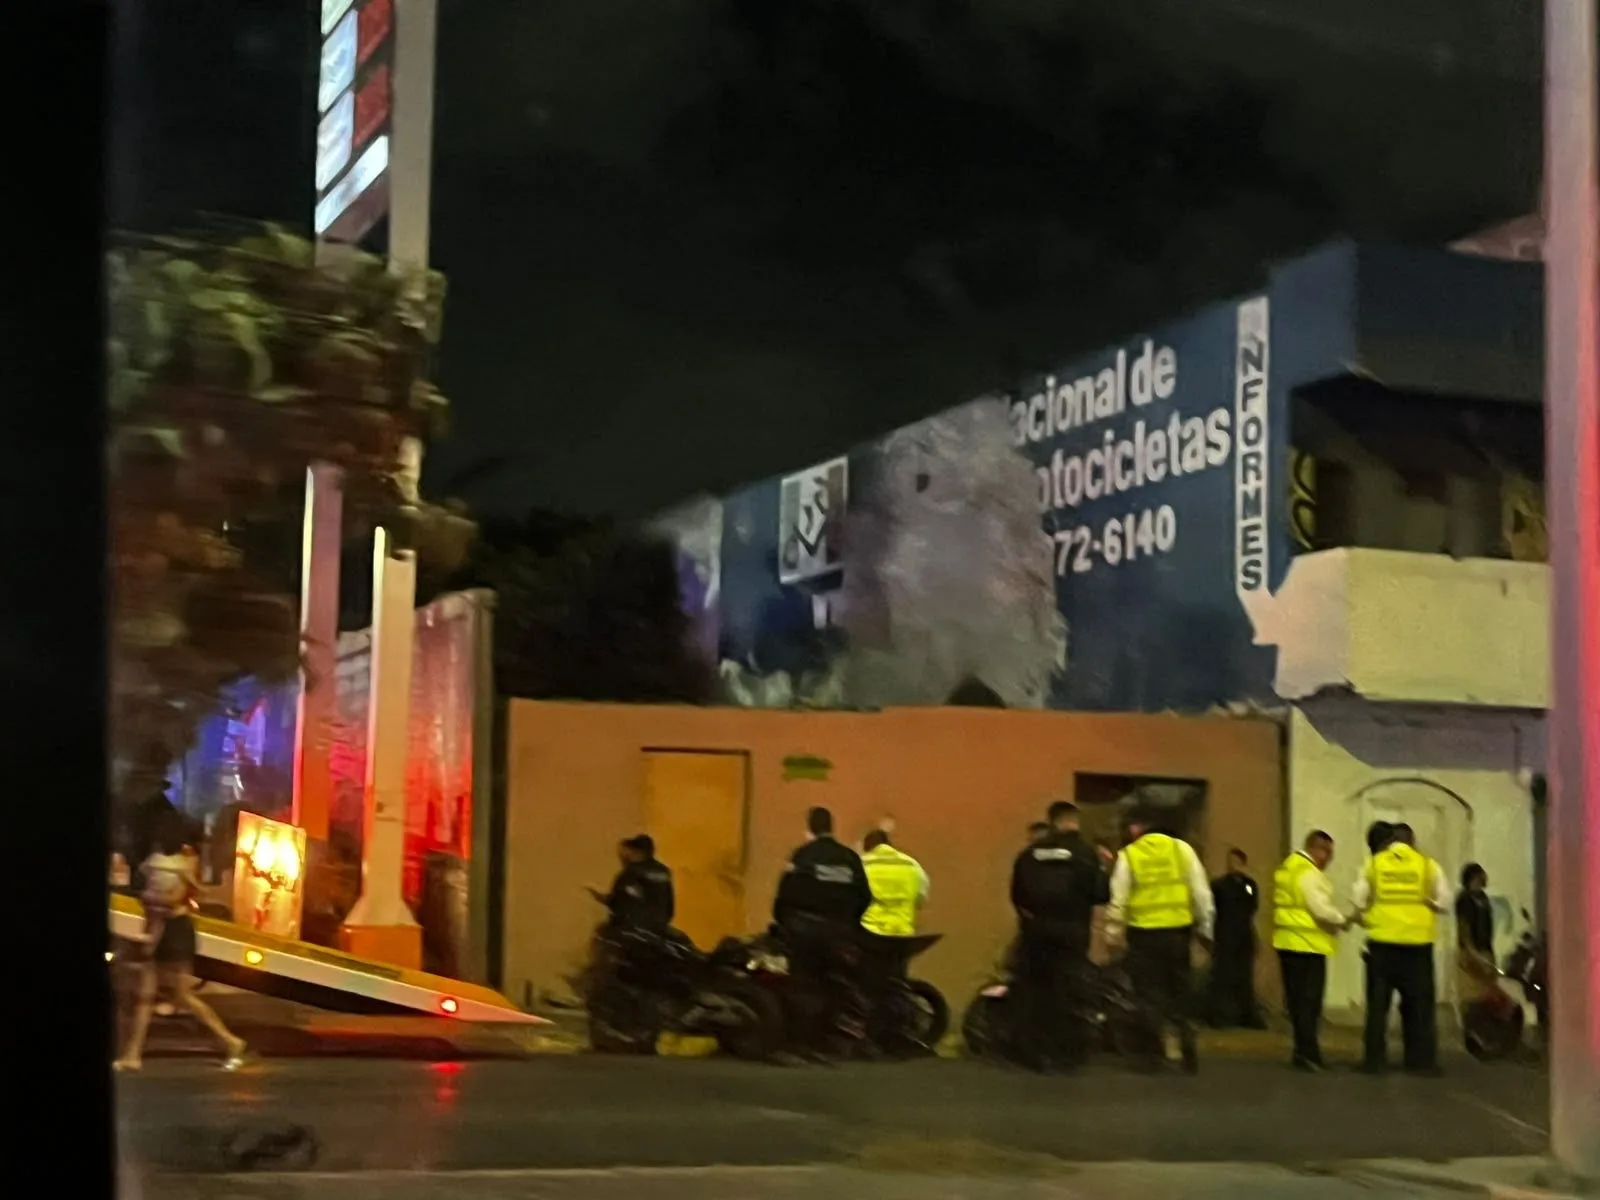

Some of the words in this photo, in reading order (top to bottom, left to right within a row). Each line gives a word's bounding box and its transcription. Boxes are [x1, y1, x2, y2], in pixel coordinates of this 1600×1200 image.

[1003, 349, 1126, 447] acional
[1131, 339, 1177, 406] de
[1036, 407, 1231, 512] otocicletas
[1241, 308, 1265, 591] NFORMES
[1053, 504, 1176, 577] 72-6140
